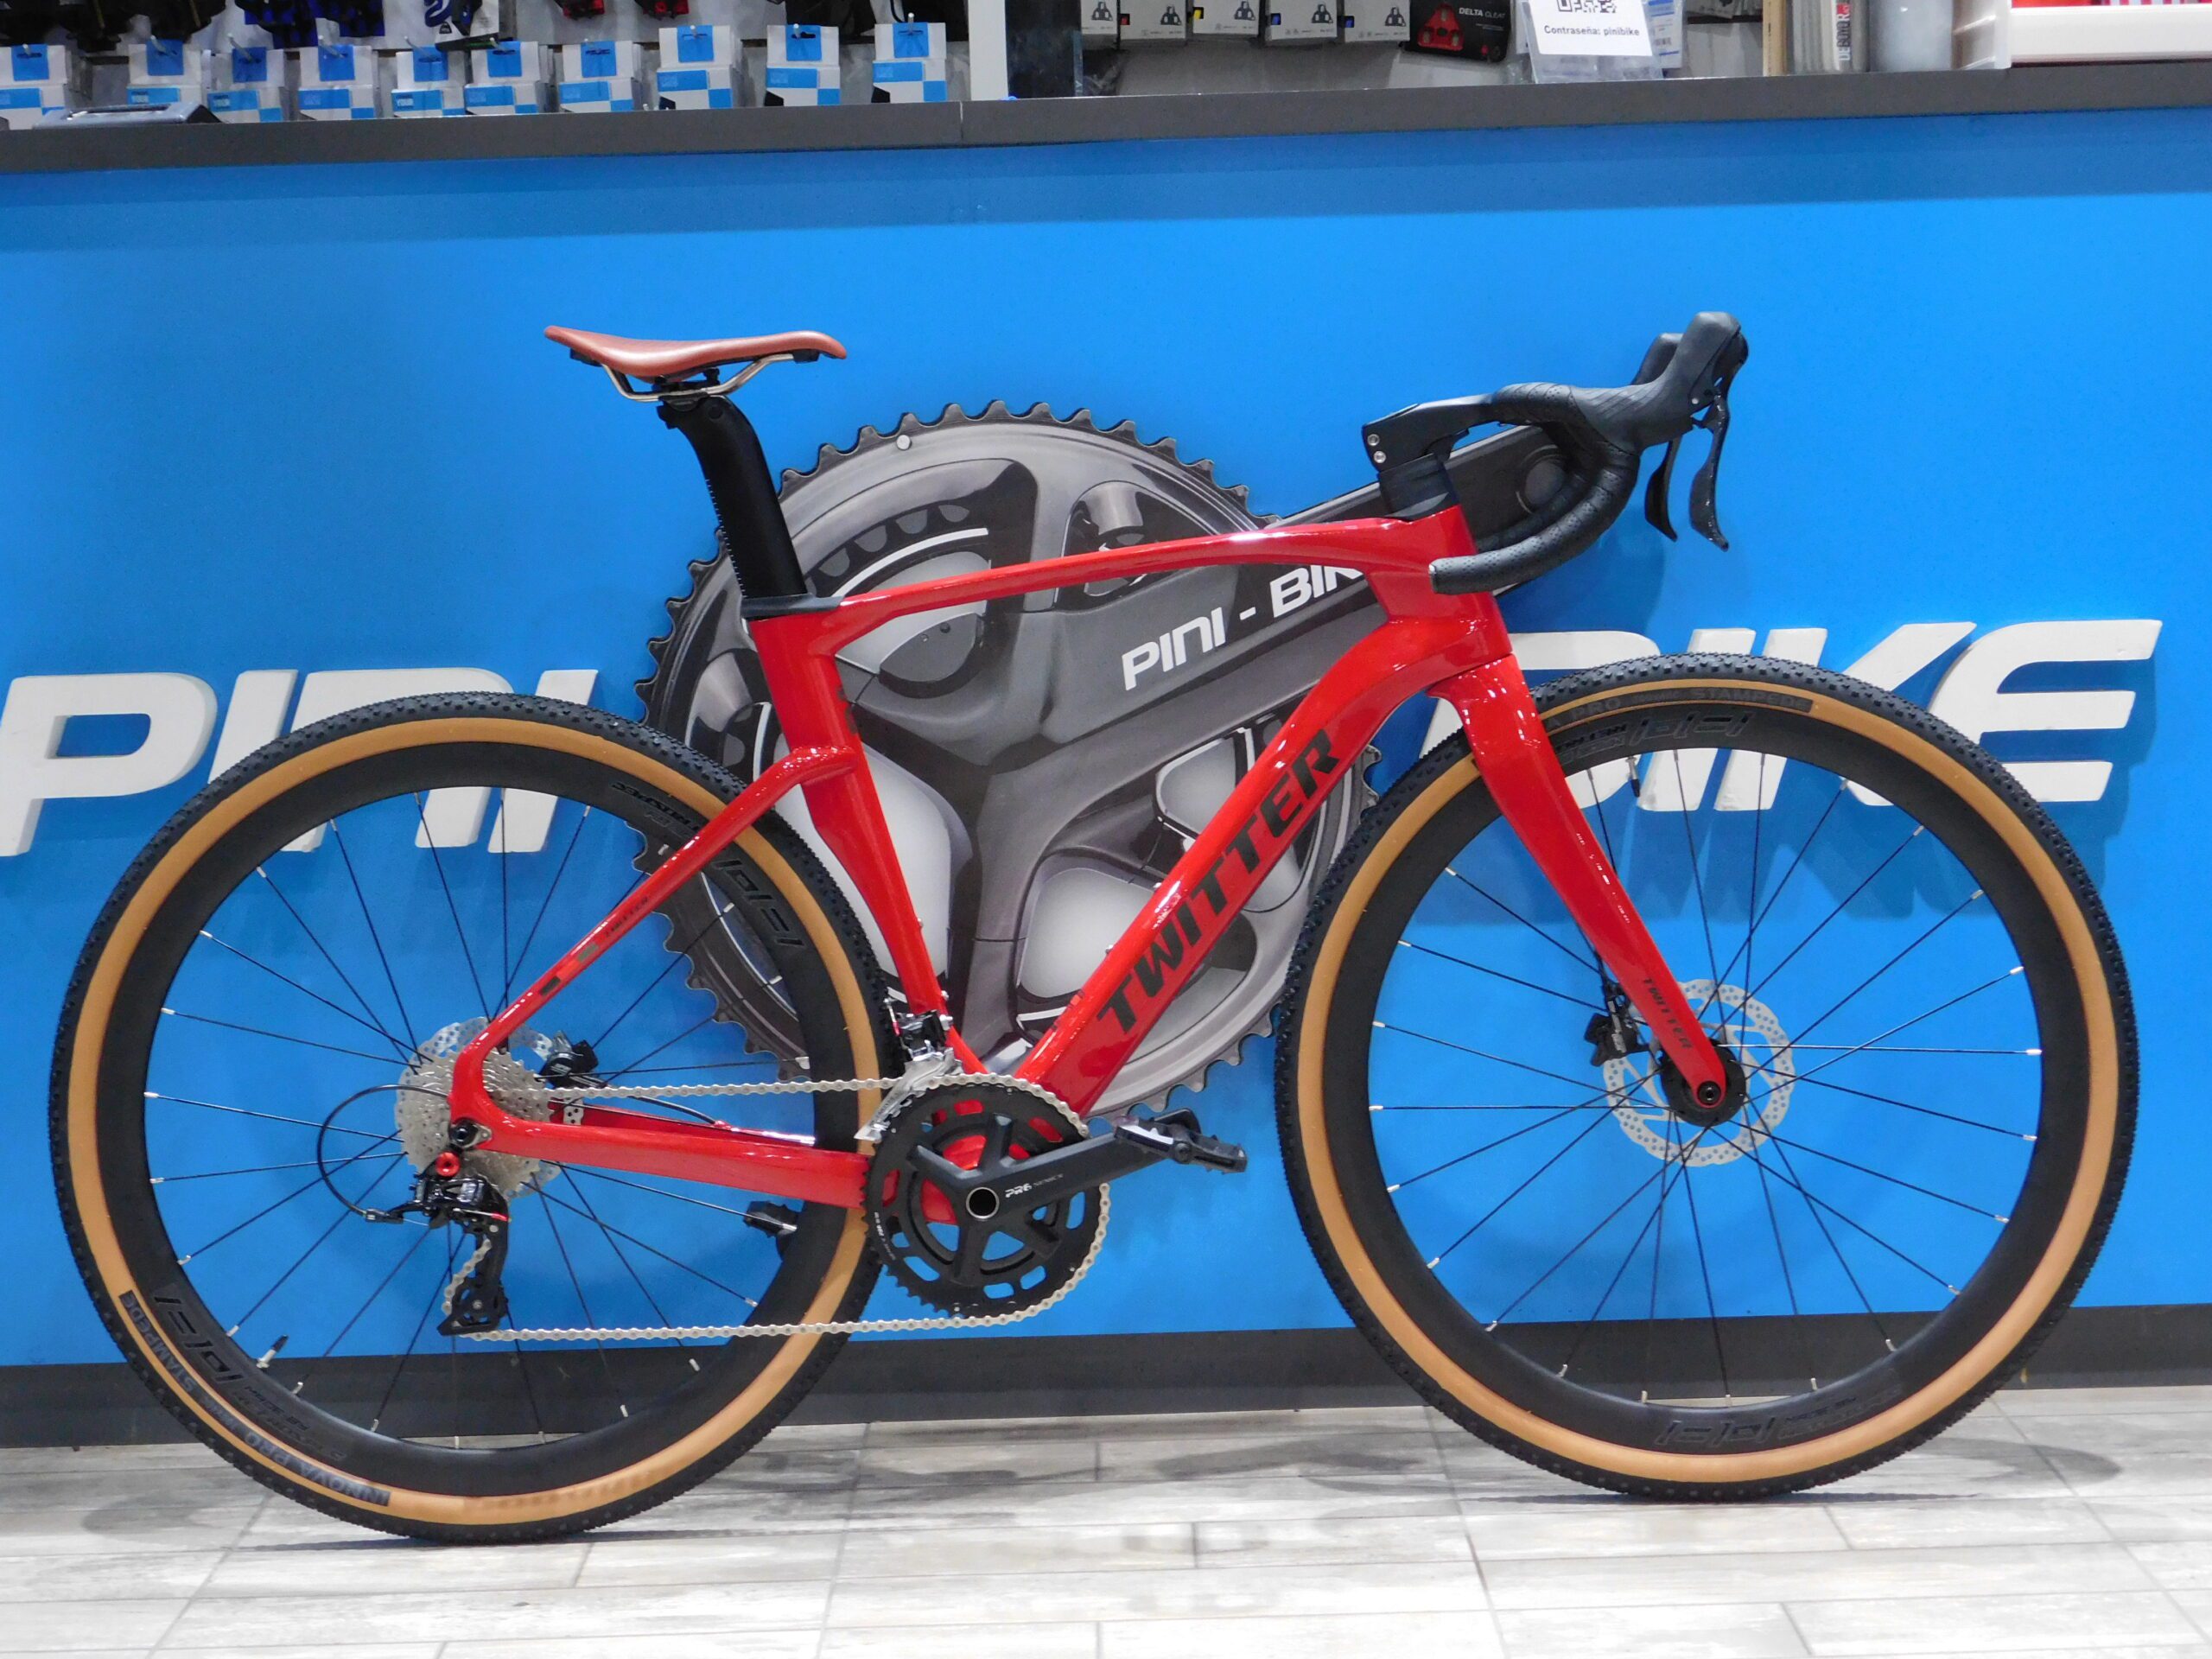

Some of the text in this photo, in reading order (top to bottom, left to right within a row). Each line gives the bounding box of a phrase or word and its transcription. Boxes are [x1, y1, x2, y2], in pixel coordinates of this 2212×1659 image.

[1459, 7, 1483, 17] DELTA
[1543, 24, 1640, 36] Contraseña: pinibike
[1122, 607, 1227, 691] PINI
[1269, 564, 1365, 618] BIK
[1097, 729, 1339, 1034] TWITTER
